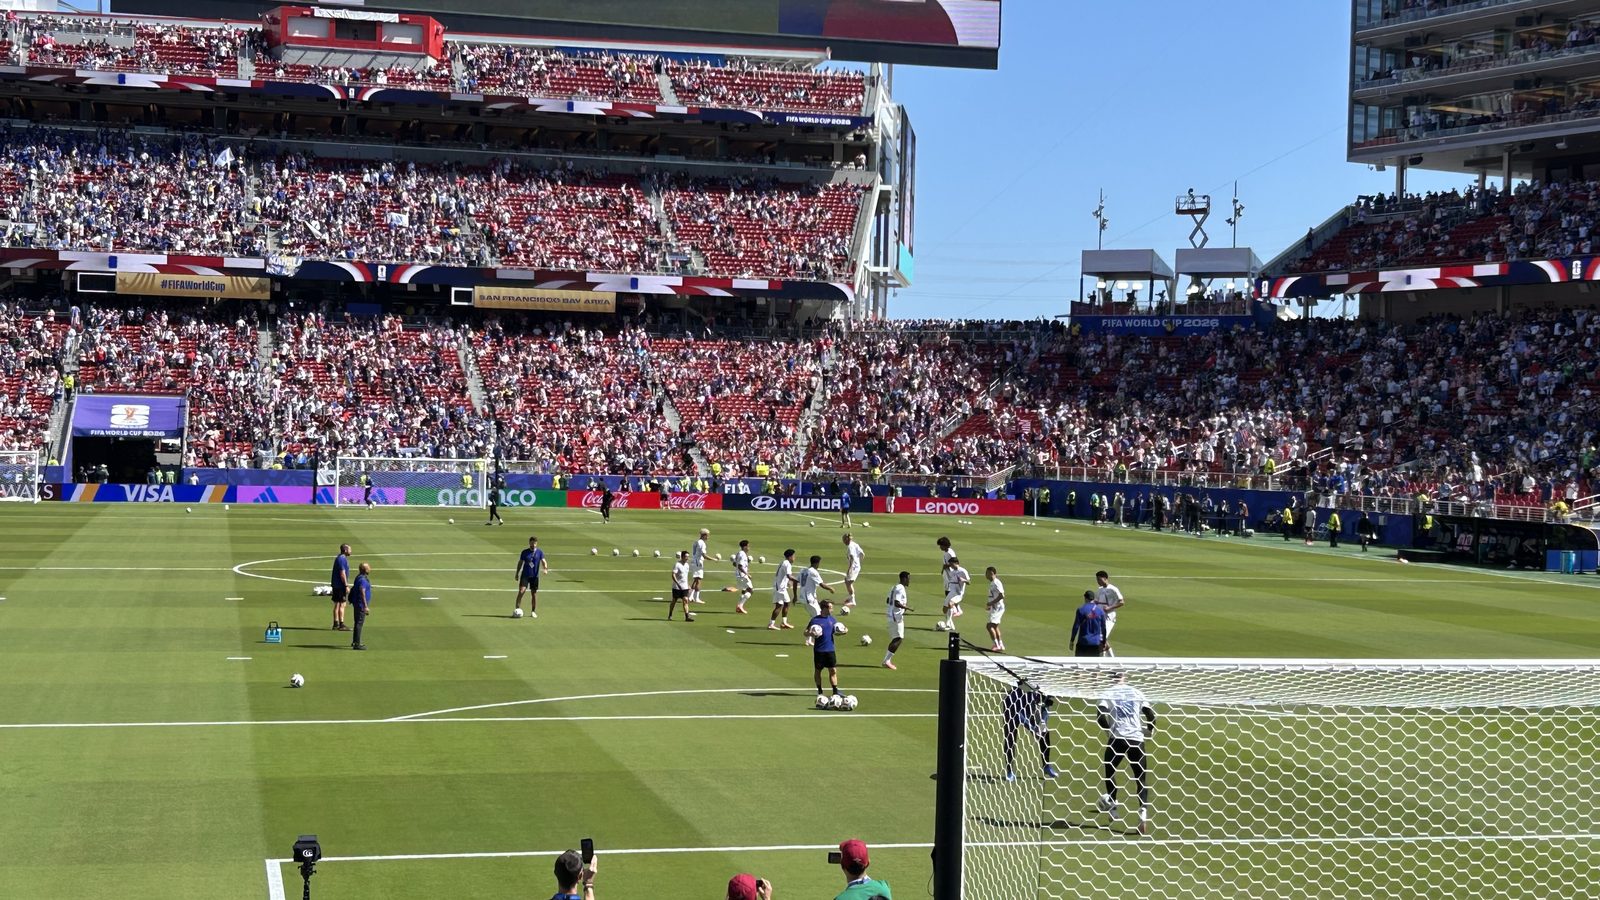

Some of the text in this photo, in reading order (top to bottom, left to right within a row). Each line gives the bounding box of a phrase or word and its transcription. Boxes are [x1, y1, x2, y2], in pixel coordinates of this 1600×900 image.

[160, 278, 226, 292] #FIFAWorldCup
[1183, 319, 1219, 327] 2026
[120, 484, 175, 502] VISA
[724, 484, 751, 494] FIA
[780, 498, 841, 509] HYUNDA
[916, 499, 980, 514] Lenovo
